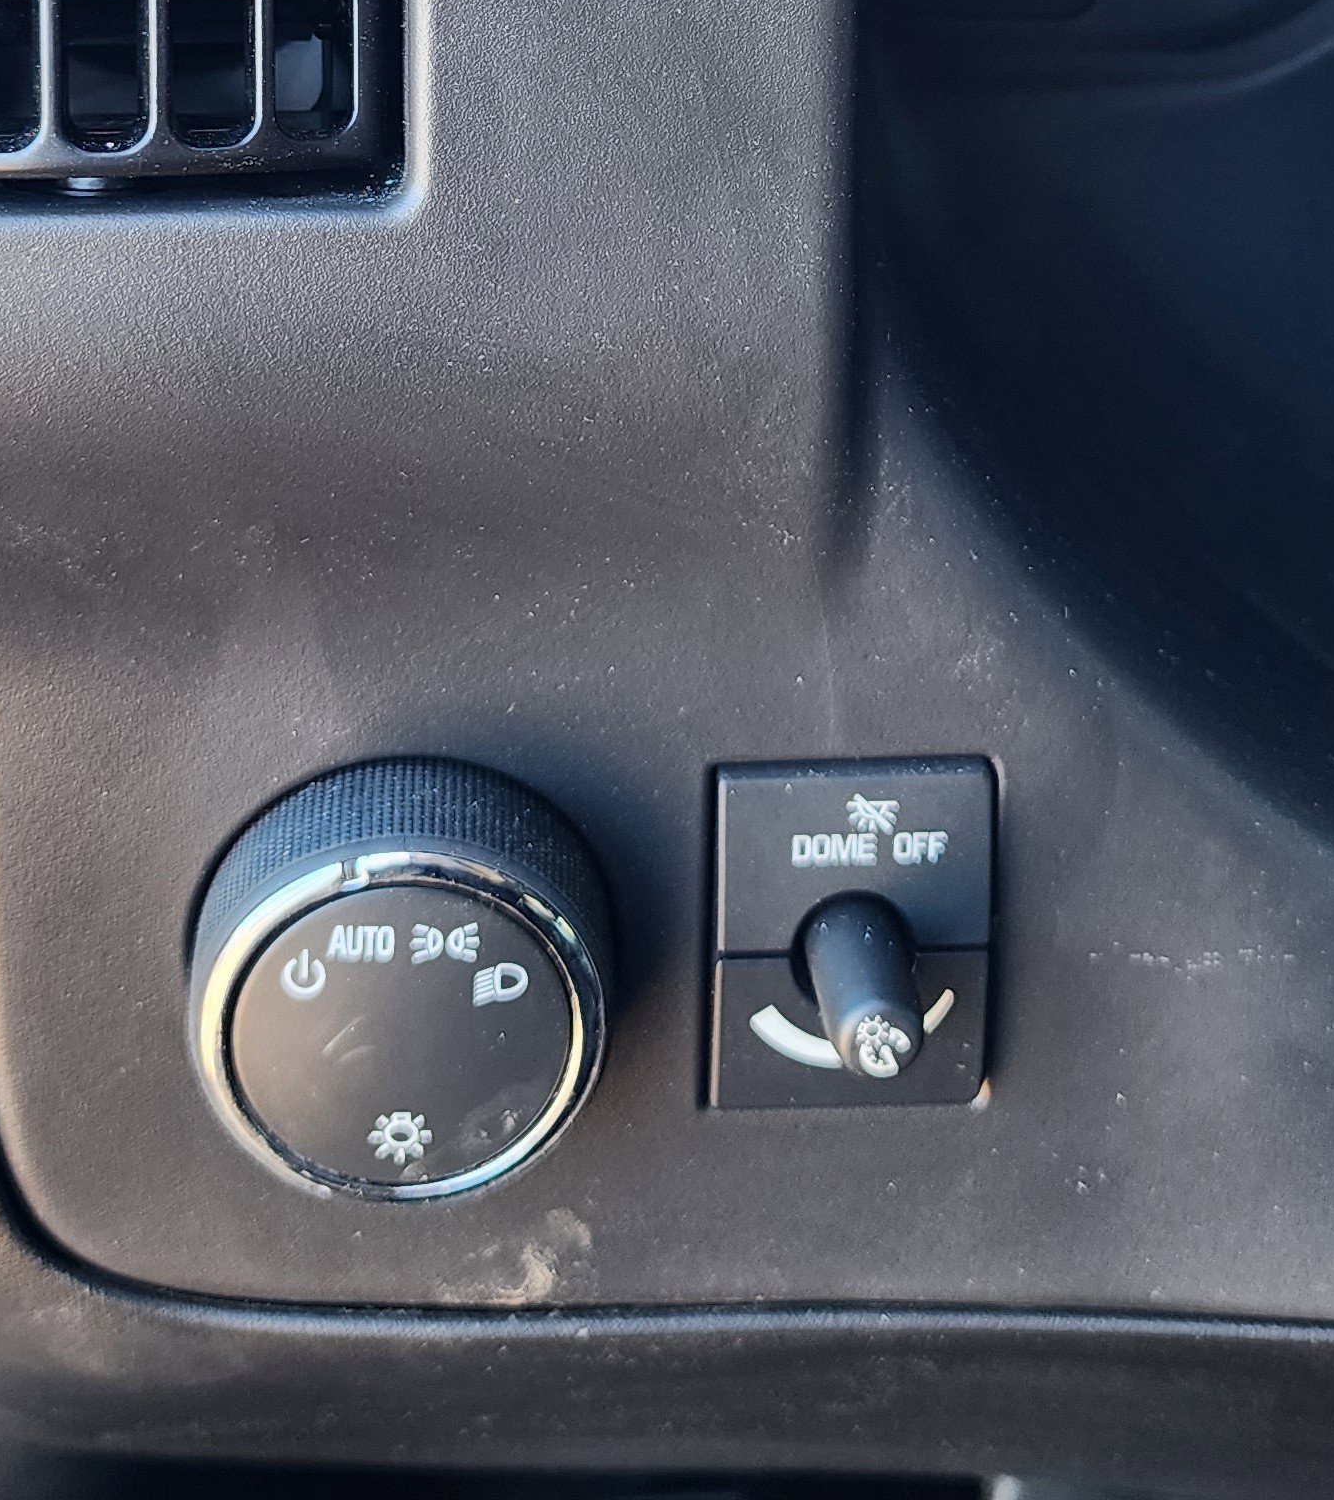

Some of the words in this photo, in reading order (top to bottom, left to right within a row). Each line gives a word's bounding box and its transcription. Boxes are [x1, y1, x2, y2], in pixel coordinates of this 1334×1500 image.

[791, 832, 878, 868] DOME
[892, 831, 950, 866] OFF
[325, 924, 395, 964] AUTO
